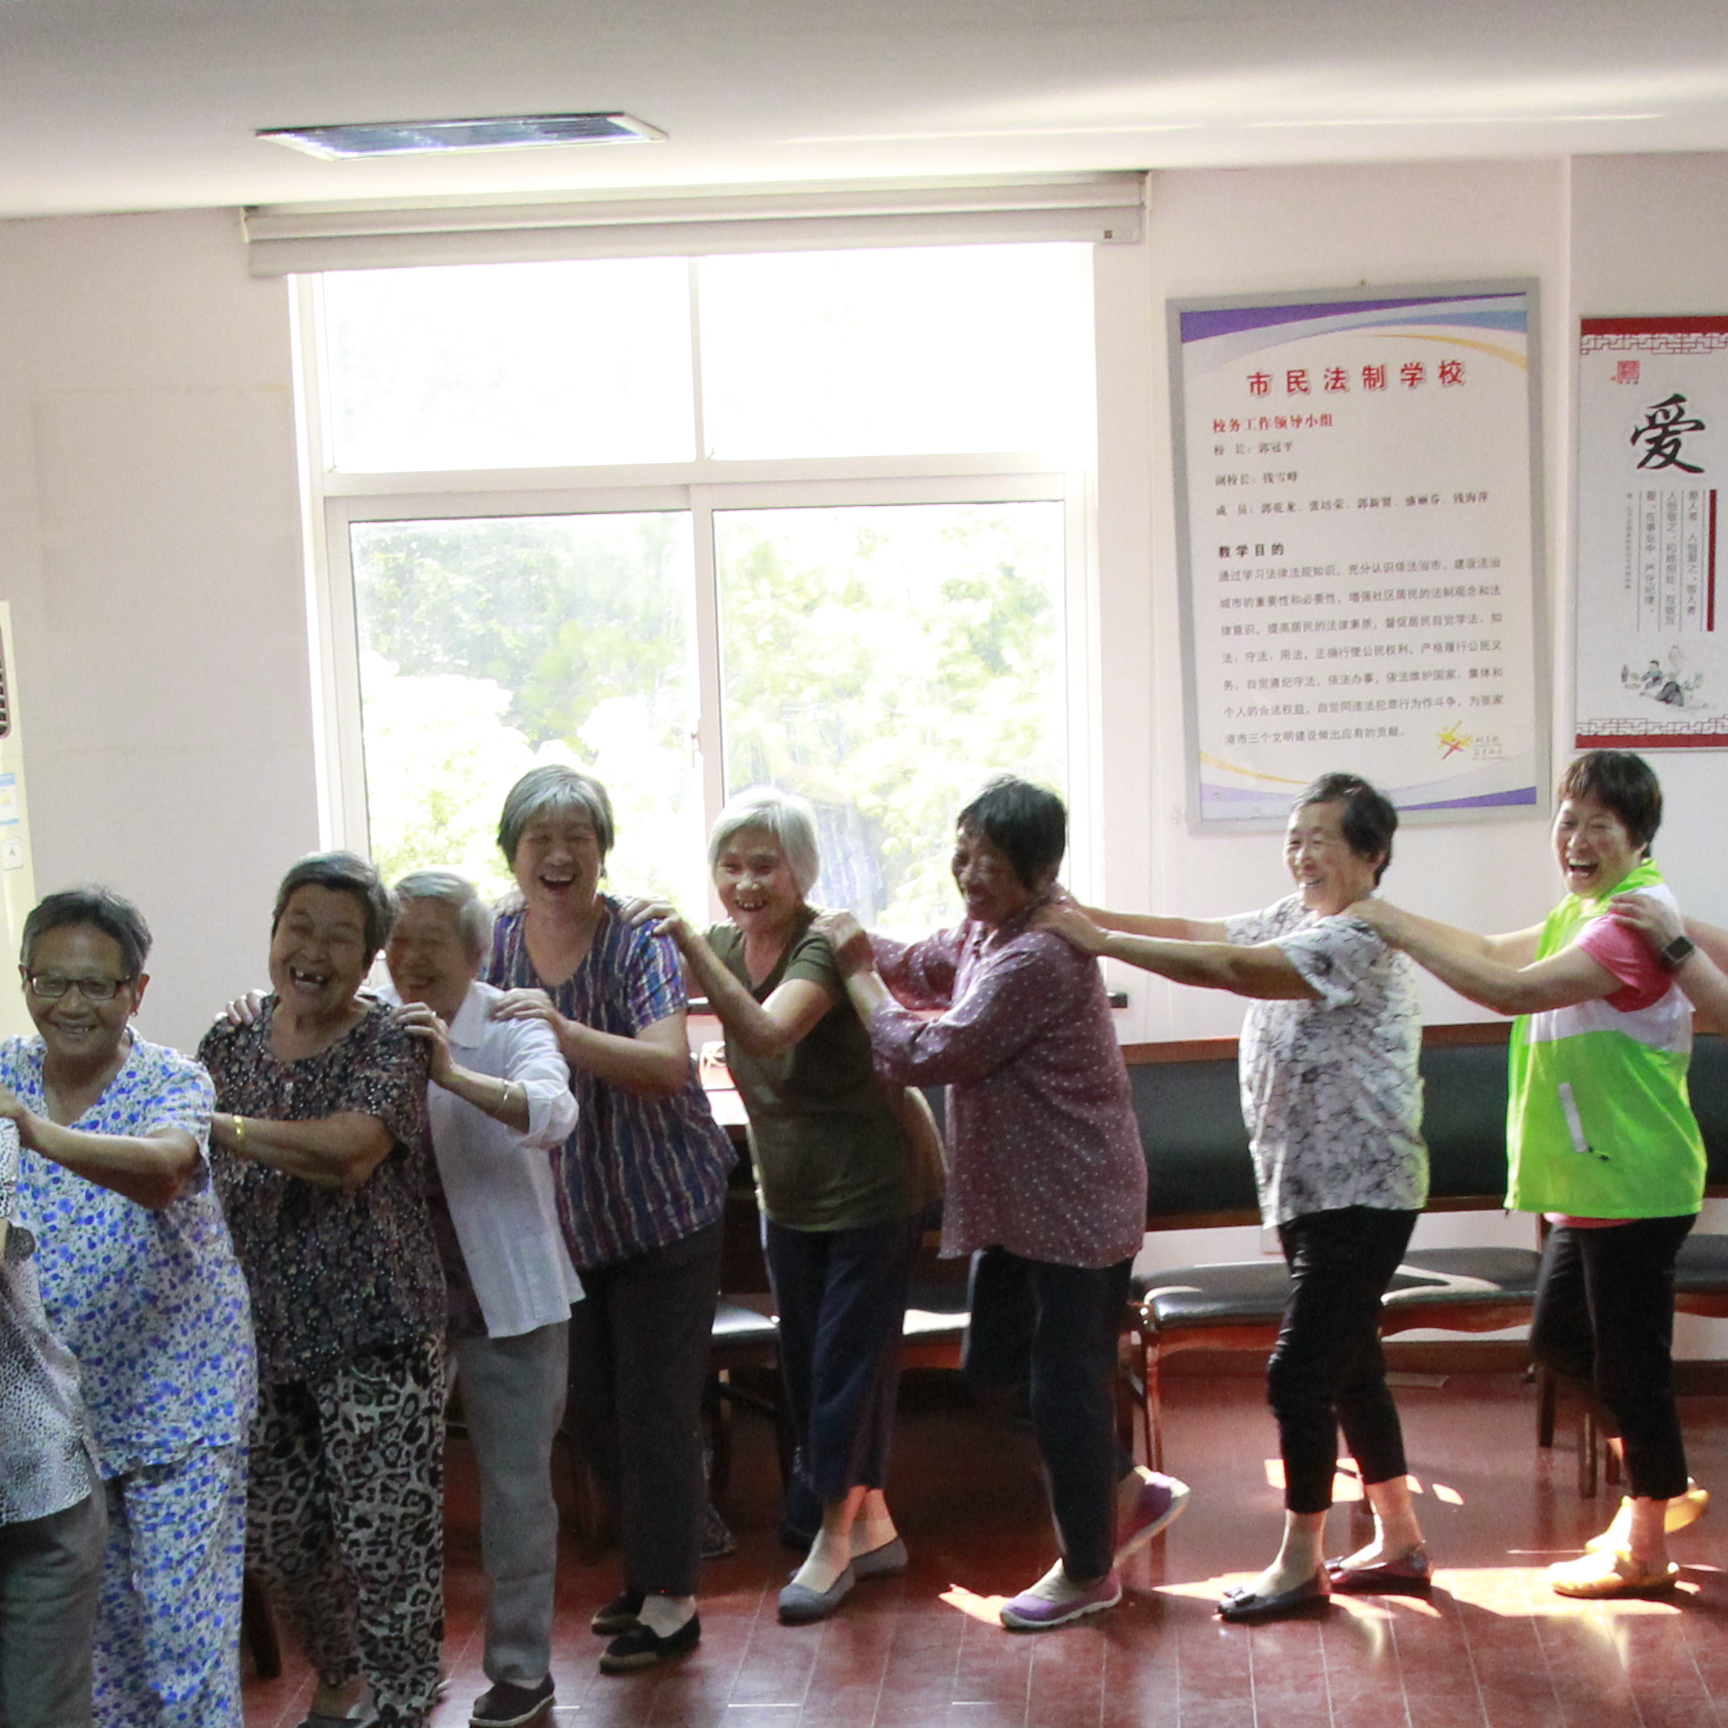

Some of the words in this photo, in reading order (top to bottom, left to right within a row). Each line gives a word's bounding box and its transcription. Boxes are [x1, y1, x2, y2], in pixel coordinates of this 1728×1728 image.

[1246, 359, 1467, 396] 市民法制学校
[1213, 413, 1334, 433] 校务工作领导小组
[1630, 393, 1705, 474] 爱
[1219, 542, 1284, 559] 教学目的
